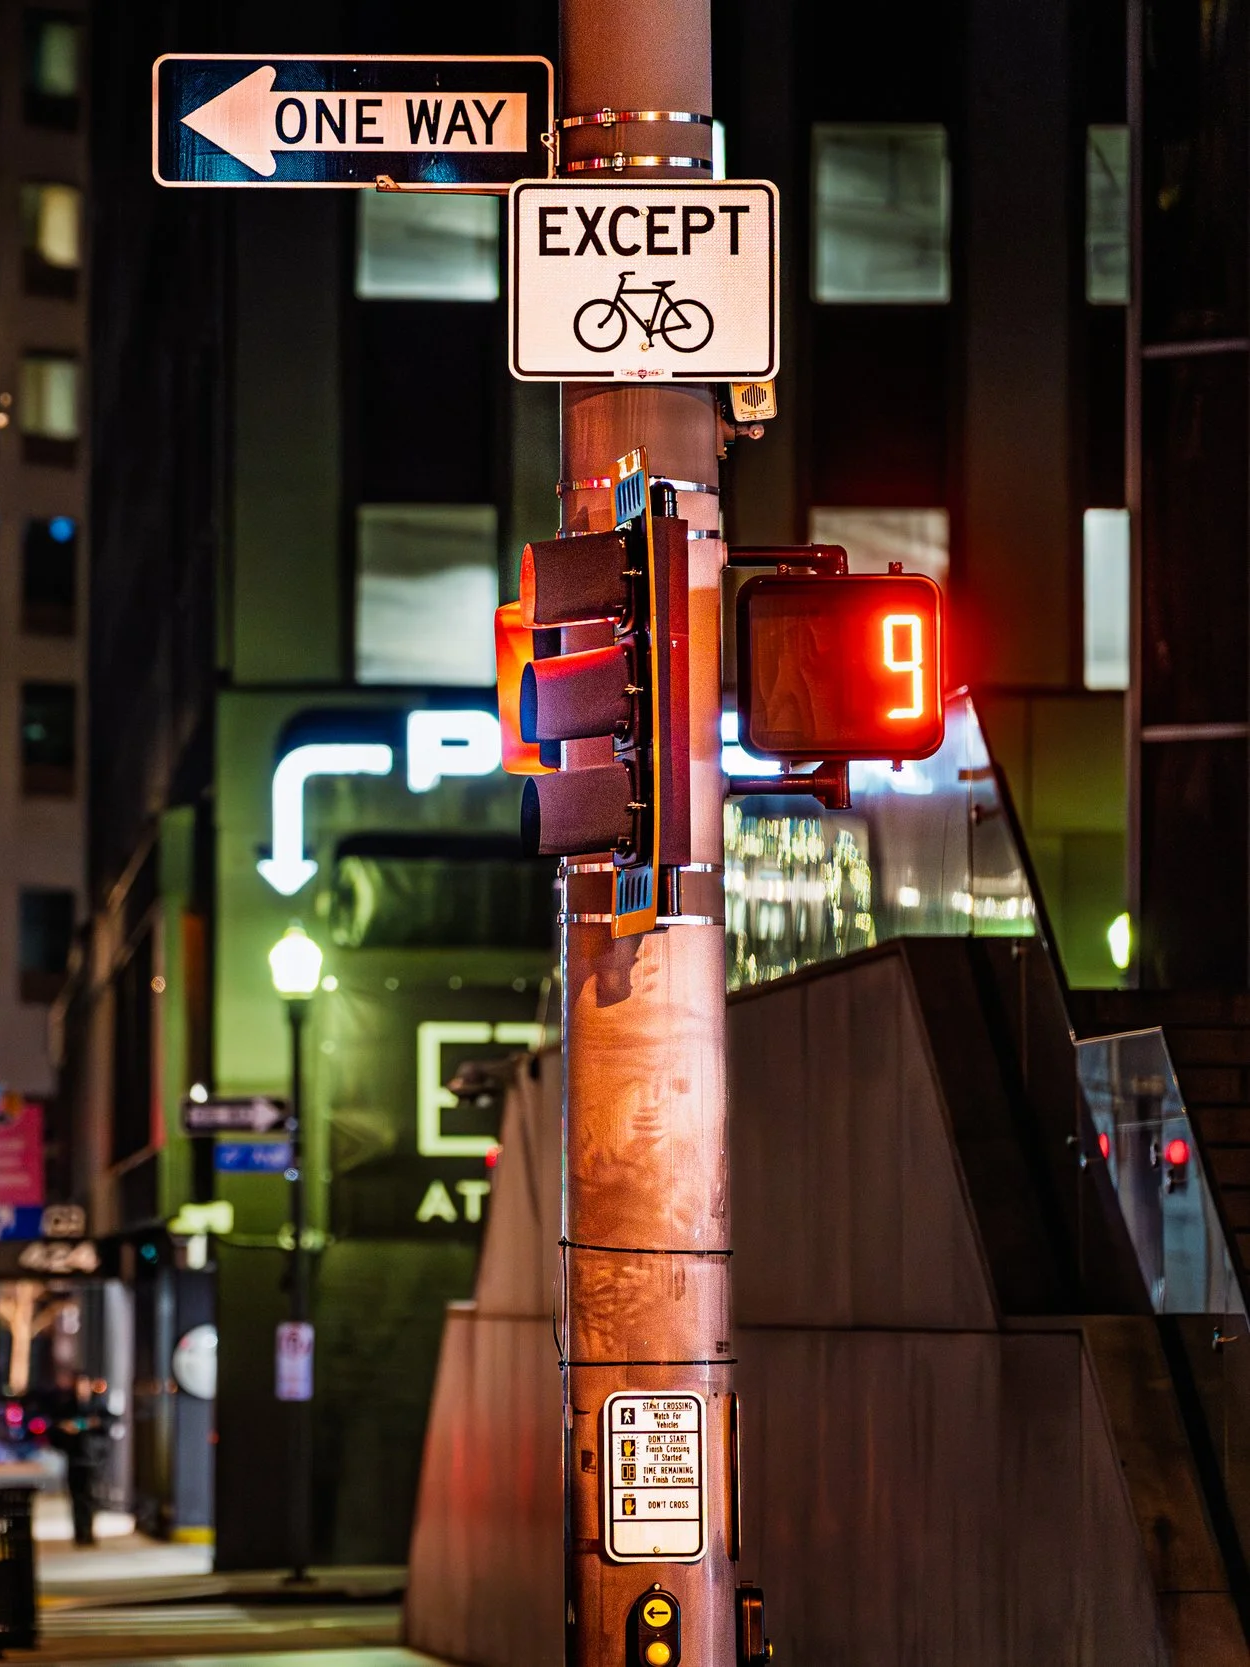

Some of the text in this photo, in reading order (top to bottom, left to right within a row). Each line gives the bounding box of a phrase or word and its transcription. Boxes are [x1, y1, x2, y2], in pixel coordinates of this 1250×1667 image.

[275, 97, 507, 145] ONE WAY
[538, 205, 750, 256] EXCEPT
[882, 614, 924, 719] 9
[642, 1402, 693, 1410] START CROSSING
[653, 1412, 682, 1420] Watch For
[656, 1421, 679, 1429] Vehicles
[648, 1435, 687, 1443] DON'T START
[645, 1445, 690, 1454] Finish Crossing
[643, 1466, 694, 1474] TIME REMAINING
[652, 1475, 669, 1483] Finish
[671, 1475, 695, 1485] Crossing
[648, 1501, 689, 1509] DON'T CROSS
